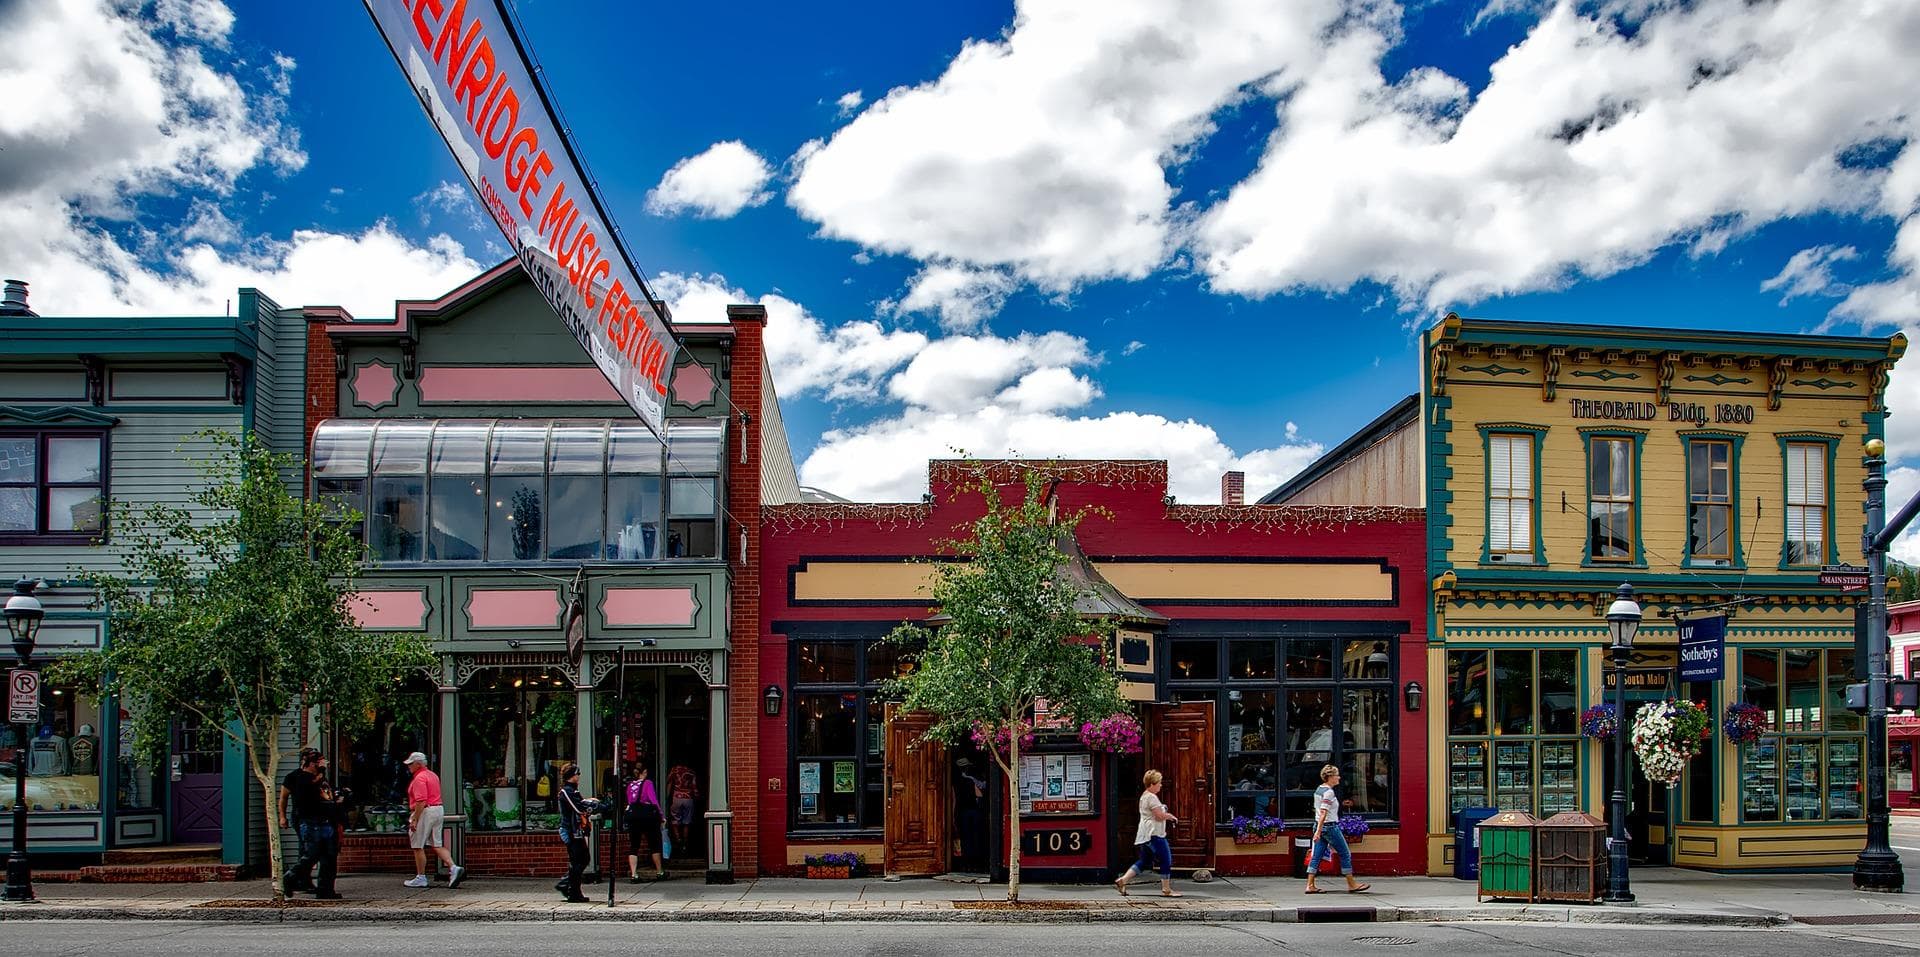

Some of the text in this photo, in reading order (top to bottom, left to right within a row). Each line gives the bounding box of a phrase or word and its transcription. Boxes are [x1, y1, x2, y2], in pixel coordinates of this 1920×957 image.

[403, 0, 554, 220] ENRIDGE
[538, 181, 610, 309] MUSIC
[598, 280, 667, 397] FESTIVAL
[1569, 398, 1755, 428] THEOBALD Bldg. 1880
[1824, 576, 1842, 584] MAIN
[1842, 576, 1868, 585] STREET
[1681, 626, 1694, 640] LIV
[1681, 645, 1718, 662] Sotheby's
[1624, 674, 1645, 685] South
[1647, 674, 1665, 685] Main
[1033, 832, 1081, 852] 103
